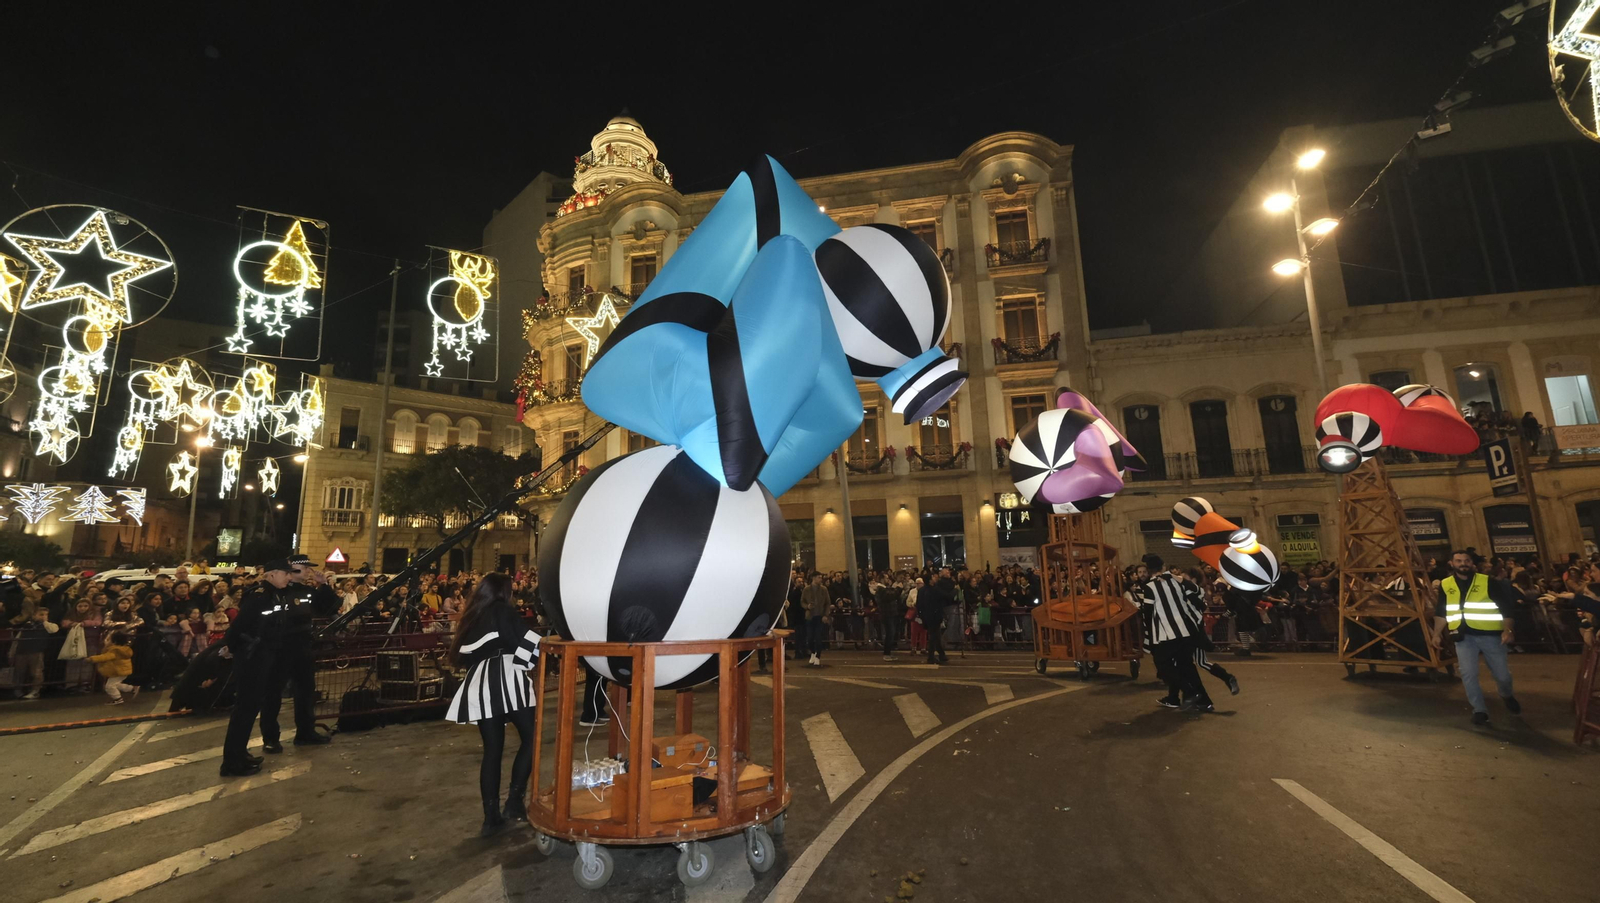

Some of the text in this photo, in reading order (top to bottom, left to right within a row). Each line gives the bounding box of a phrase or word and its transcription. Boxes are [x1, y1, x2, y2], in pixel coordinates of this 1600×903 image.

[1489, 445, 1505, 477] P
[1281, 532, 1316, 541] SE VENDE
[1494, 537, 1534, 545] DISPONIBLE
[1282, 543, 1318, 551] O ALQUILA
